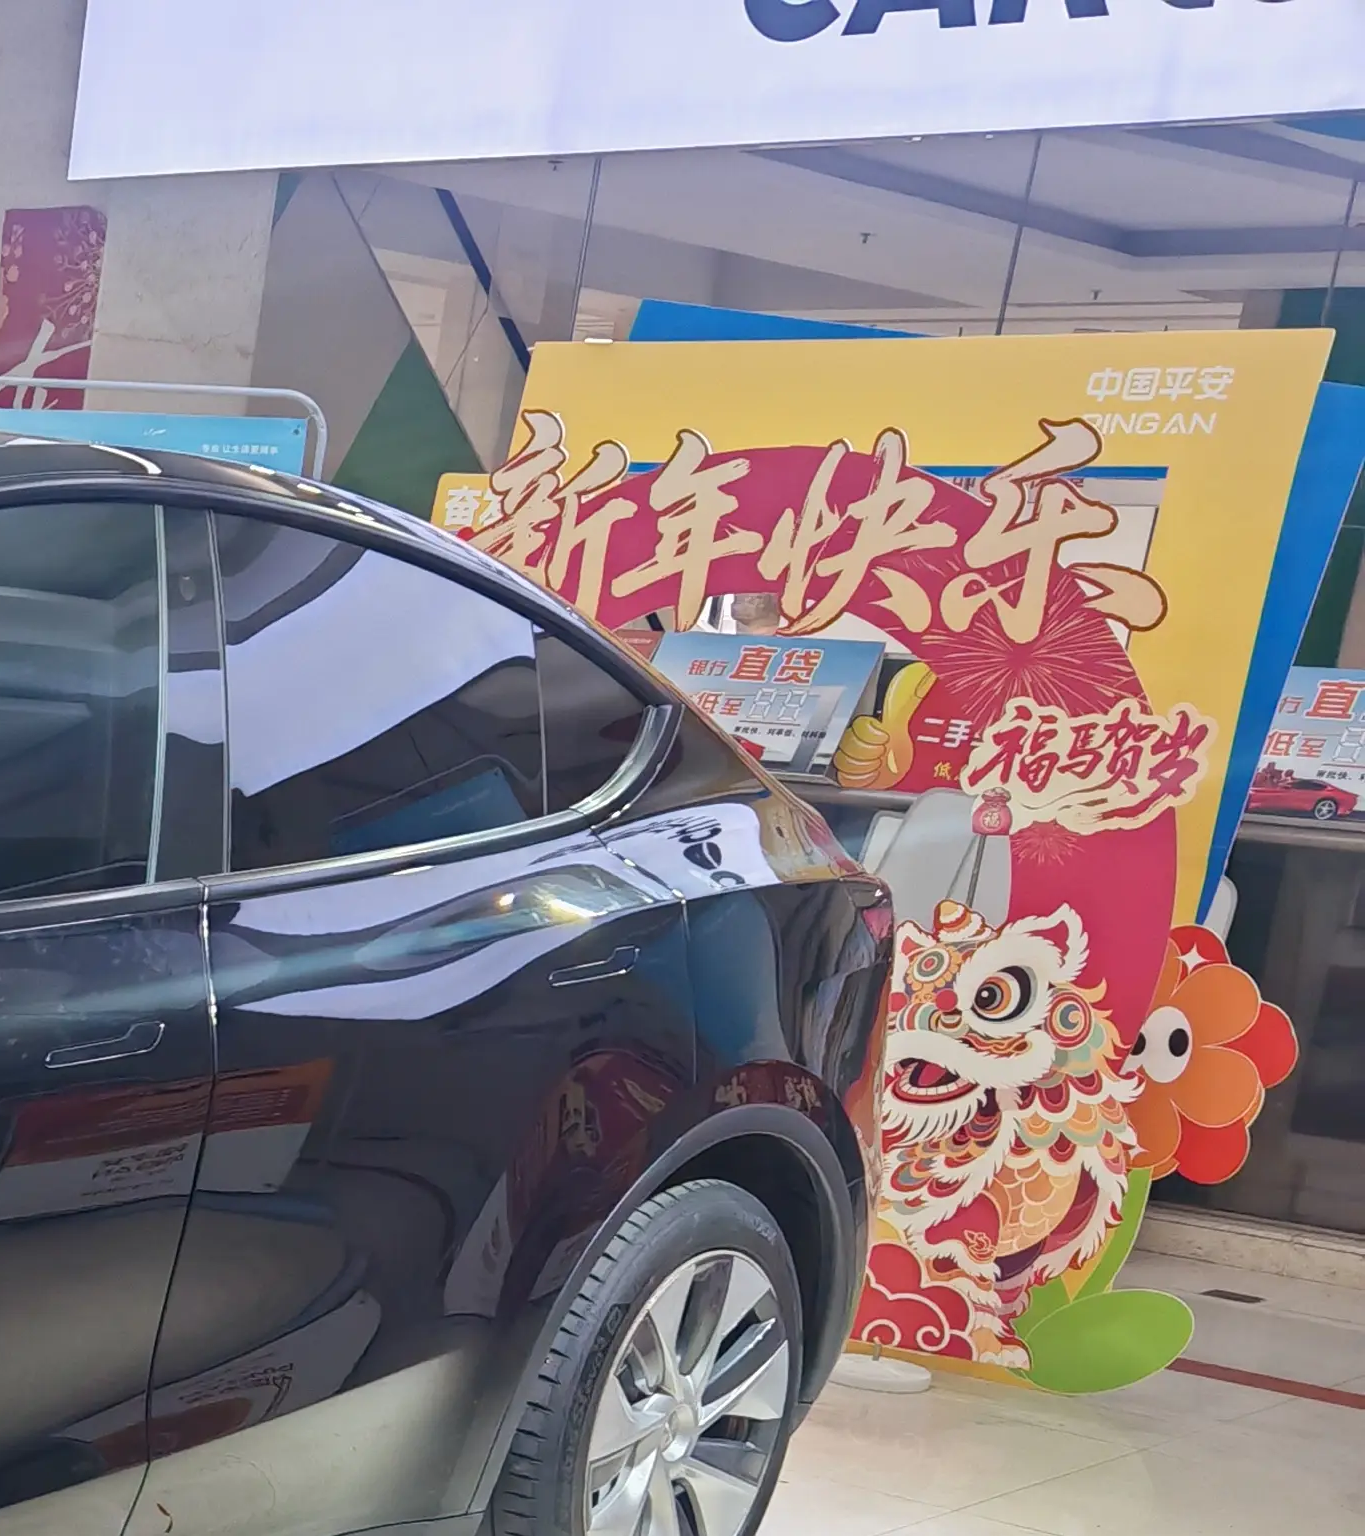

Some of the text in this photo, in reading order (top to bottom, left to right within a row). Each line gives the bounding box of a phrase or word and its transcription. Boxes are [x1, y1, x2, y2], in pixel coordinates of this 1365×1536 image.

[1087, 366, 1235, 402] 中国平安
[469, 409, 1168, 643] 新年快乐
[696, 691, 745, 716] 低至
[917, 717, 983, 748] 二手
[1264, 730, 1326, 757] 低至
[969, 706, 1209, 798] 福马贺岁
